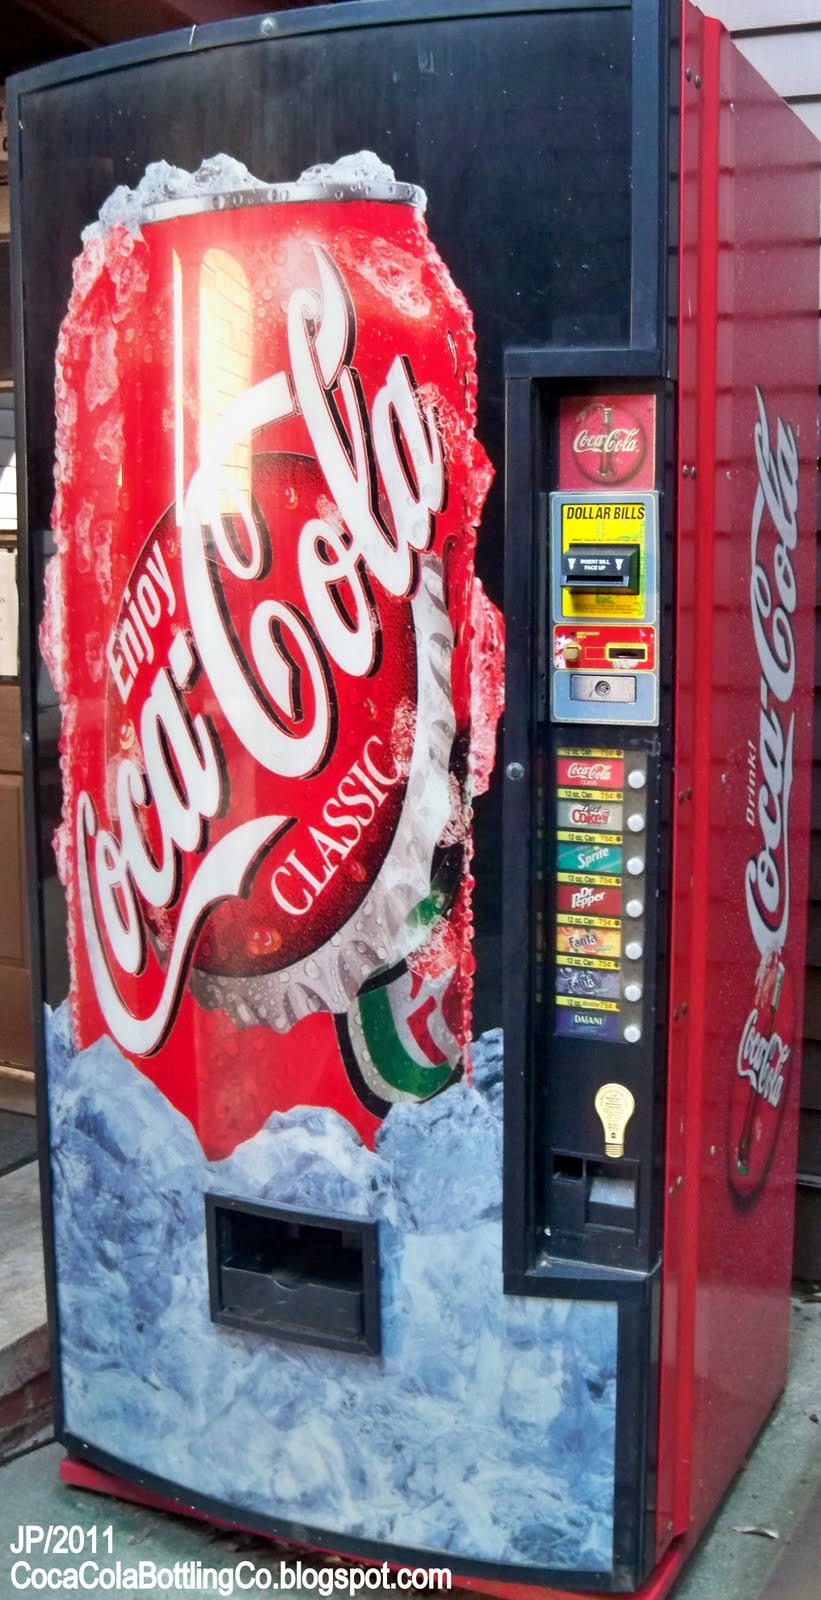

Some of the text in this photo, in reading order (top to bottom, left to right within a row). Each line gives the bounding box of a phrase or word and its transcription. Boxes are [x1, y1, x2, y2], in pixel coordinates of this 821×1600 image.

[573, 428, 639, 453] Coca-Cola
[567, 506, 645, 520] DOLLAR BILLS
[105, 540, 176, 704] Enjoy
[572, 809, 602, 824] Coke
[270, 736, 402, 915] CLASSIC
[577, 847, 609, 868] Sprite
[580, 887, 594, 897] Dr
[571, 892, 605, 908] Pepper
[568, 934, 598, 949] Fanta
[574, 1014, 602, 1025] DASANI
